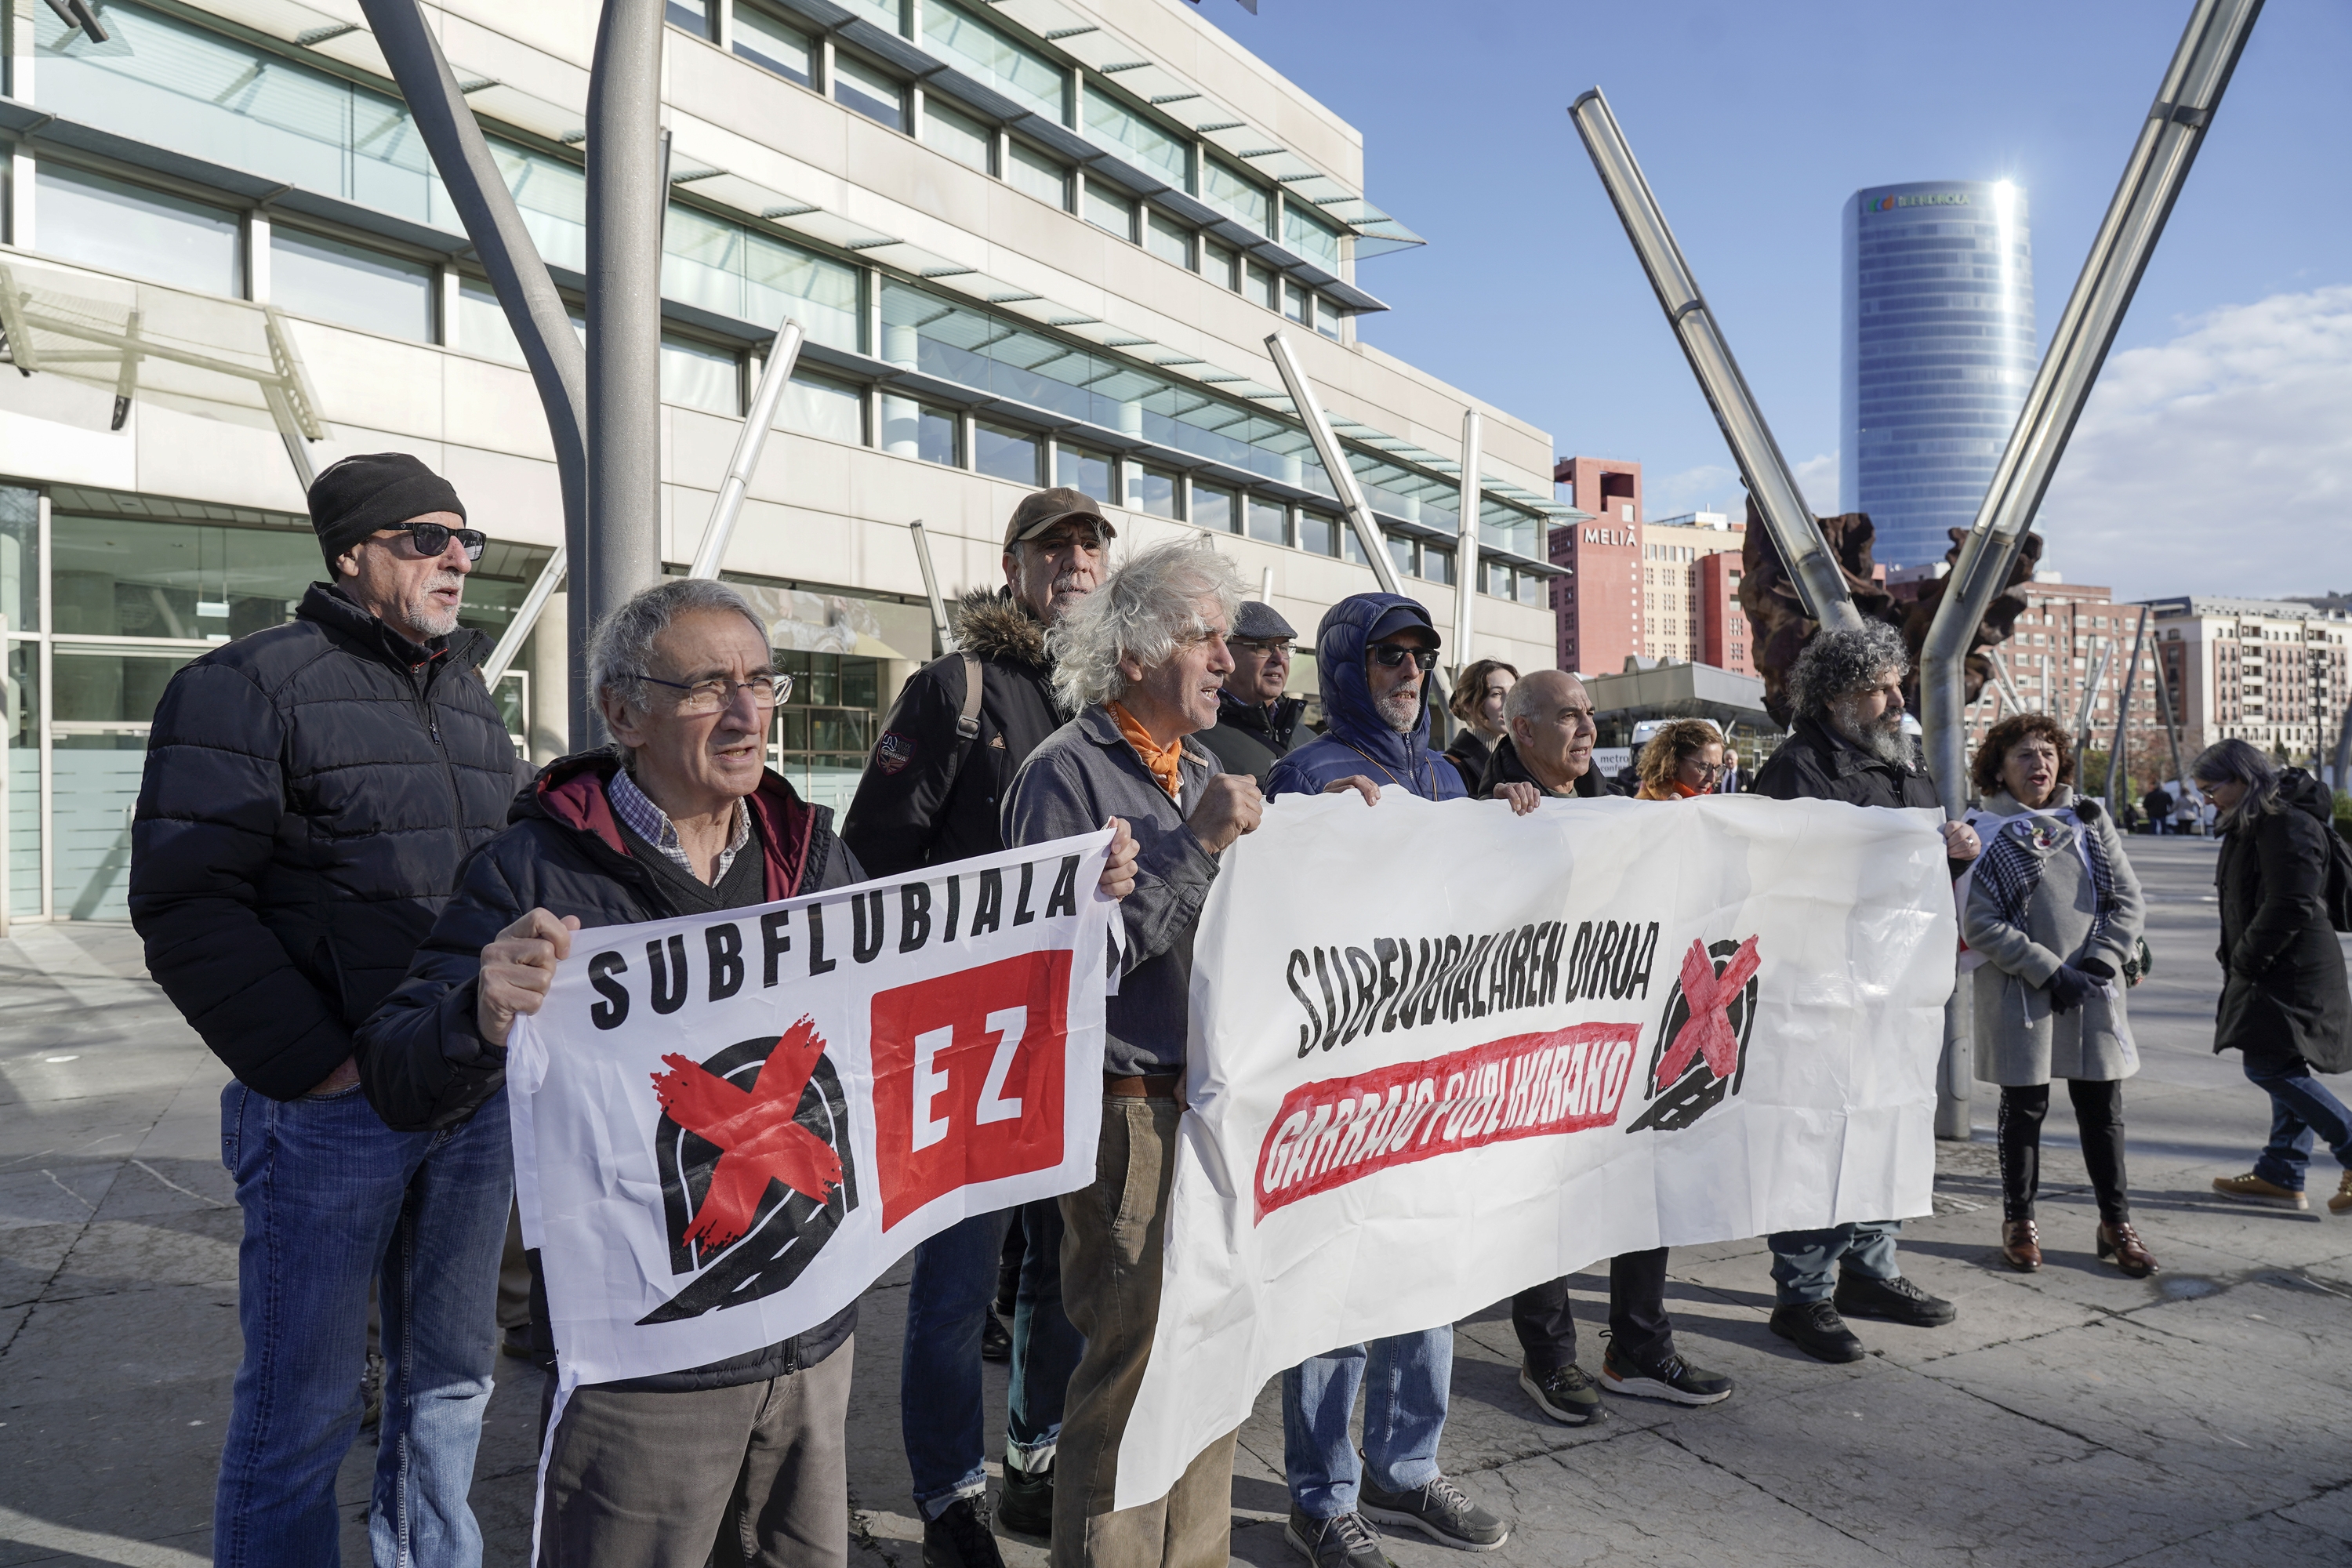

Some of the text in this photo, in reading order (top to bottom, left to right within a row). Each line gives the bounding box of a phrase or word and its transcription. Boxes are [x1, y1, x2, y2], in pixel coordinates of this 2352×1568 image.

[1899, 194, 1969, 207] IBERDROLA
[881, 749, 906, 761] TERNUA
[1600, 754, 1629, 763] metro
[588, 855, 1081, 1030] SUBFLUBIALA
[1566, 920, 1660, 1004] DIRUA
[912, 1005, 1029, 1153] EZ
[1263, 1078, 1436, 1194] GARRAIO
